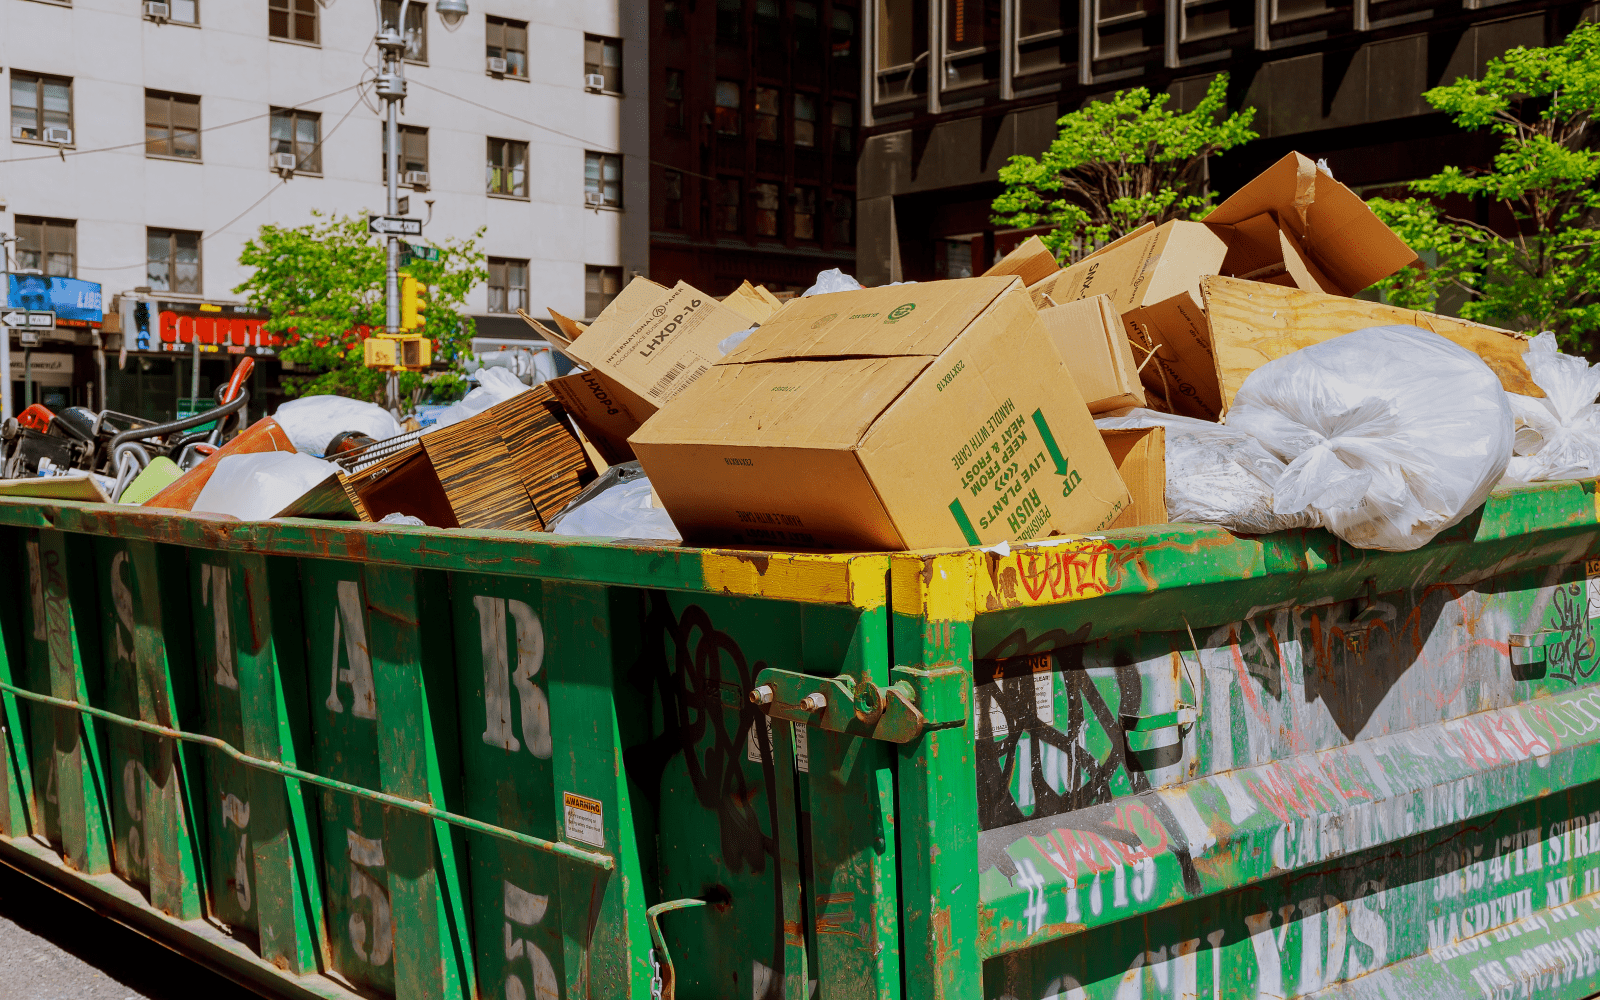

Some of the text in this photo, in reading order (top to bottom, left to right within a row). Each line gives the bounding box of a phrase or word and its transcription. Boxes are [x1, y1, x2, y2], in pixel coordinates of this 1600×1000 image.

[376, 221, 390, 229] ONE
[606, 317, 654, 364] INTERNATIONAL
[665, 287, 684, 306] PAPER
[639, 299, 702, 358] LHXDP-16
[581, 373, 619, 415] LHXDP-8
[936, 359, 966, 392] 23X18X18
[951, 397, 1016, 471] HANDLE WITH CARE
[1001, 414, 1026, 446] HEAT
[960, 450, 993, 490] FROST
[970, 430, 1028, 497] KEEP FROM
[1061, 469, 1082, 498] UP
[979, 451, 1047, 530] LIVE PLANTS
[1006, 488, 1042, 534] RUSH
[569, 796, 600, 813] WARNING
